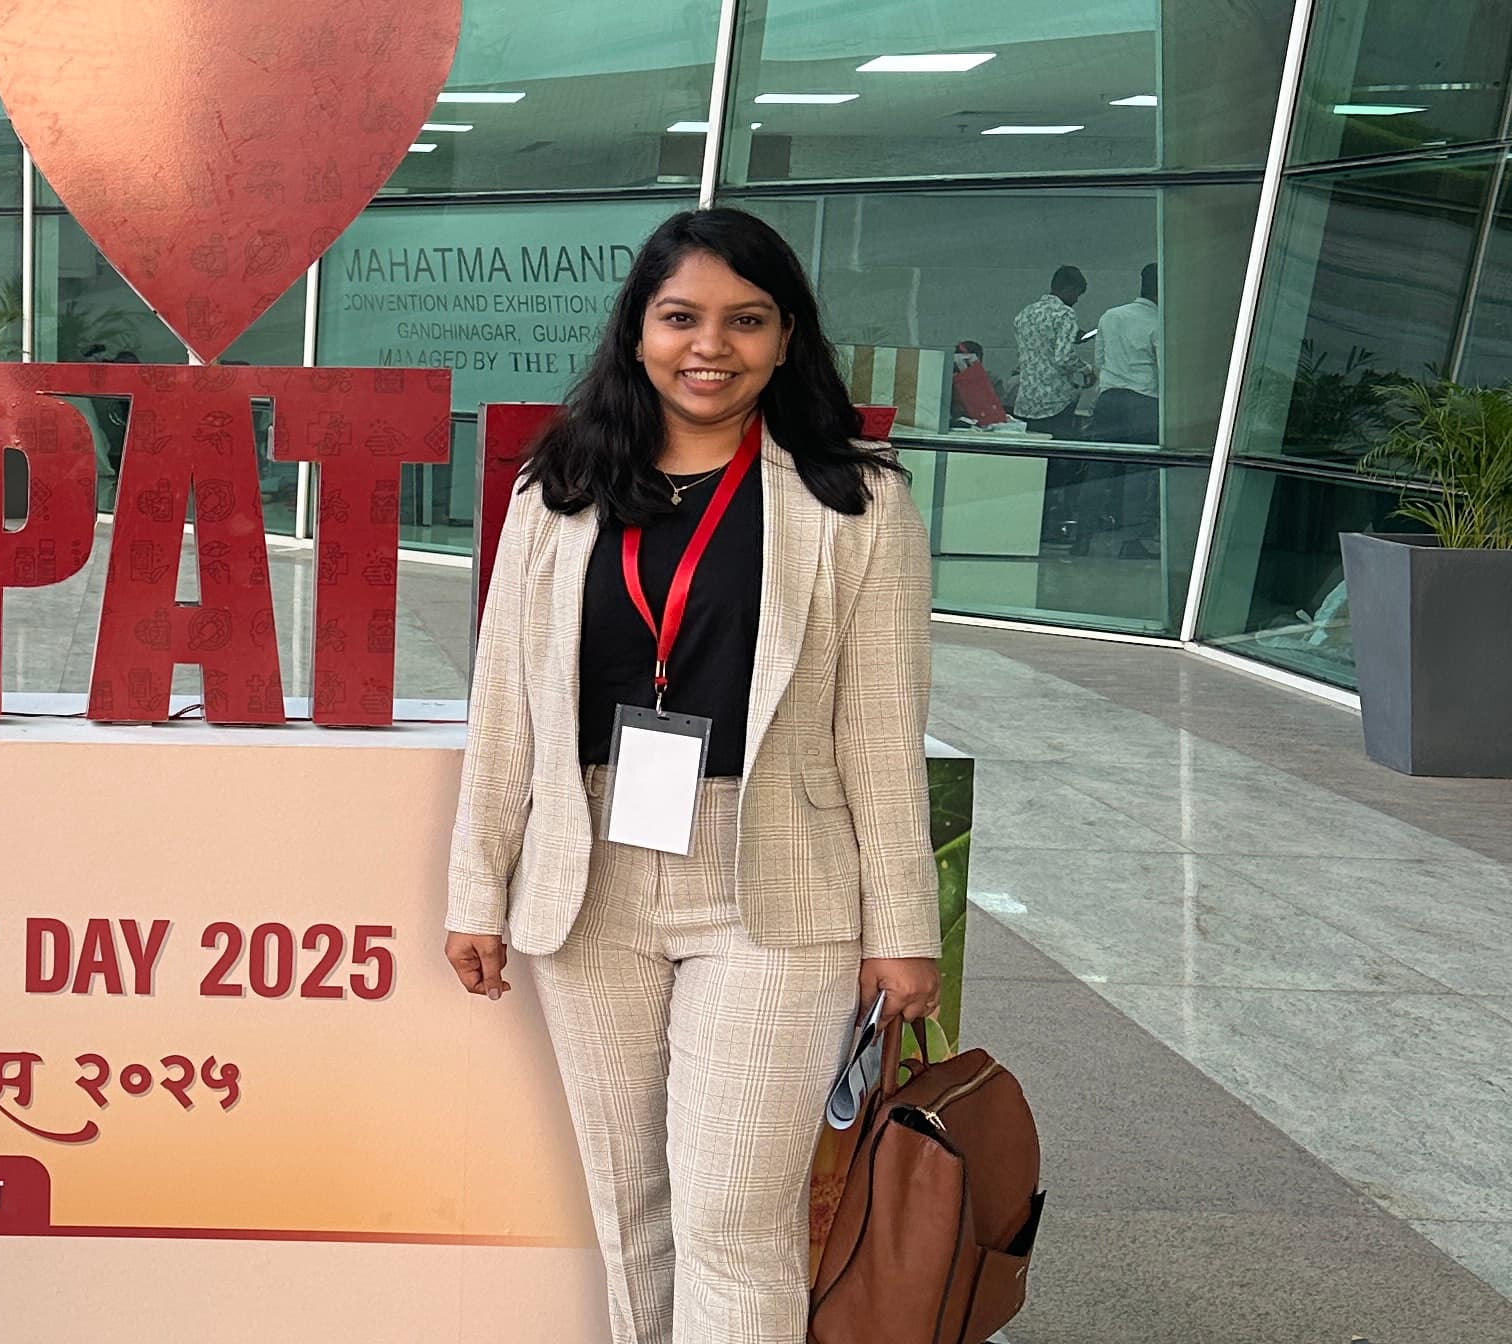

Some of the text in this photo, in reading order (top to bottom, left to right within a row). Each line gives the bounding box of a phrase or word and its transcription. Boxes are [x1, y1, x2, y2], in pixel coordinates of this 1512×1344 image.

[343, 245, 635, 283] MAHATMA MAND
[452, 294, 488, 313] AND
[493, 294, 597, 314] EXHIBITION
[397, 322, 602, 344] GANDHINAGAR, GUJARA
[473, 351, 498, 371] BY
[510, 352, 559, 374] THE
[24, 917, 172, 997] DAY
[199, 921, 395, 1001] 2025
[74, 1052, 241, 1111] २०२५
